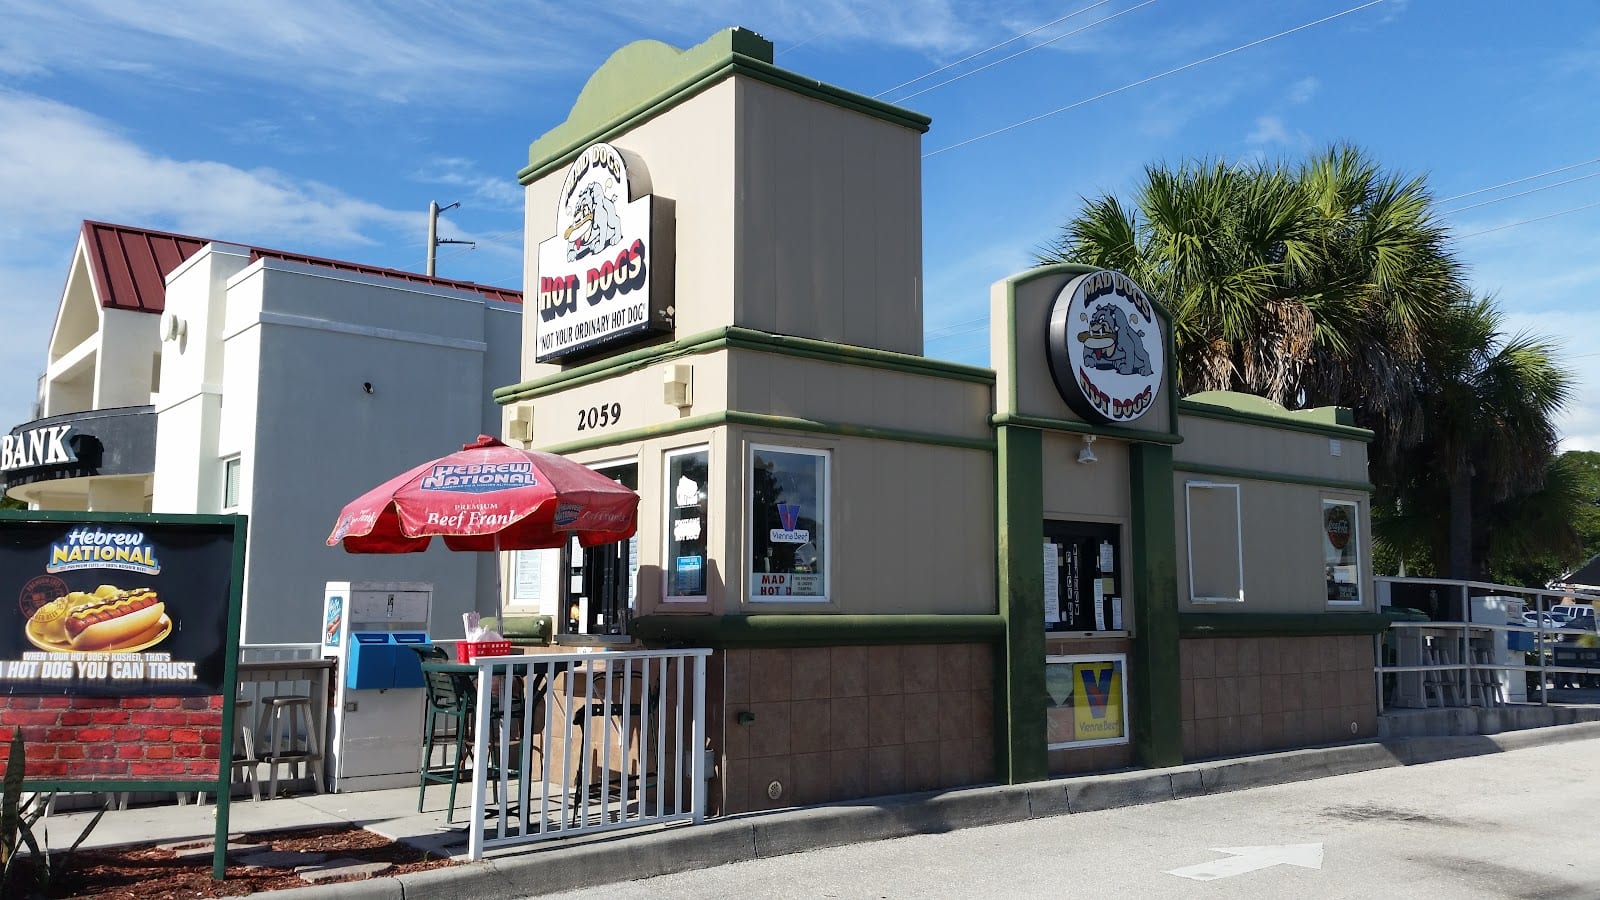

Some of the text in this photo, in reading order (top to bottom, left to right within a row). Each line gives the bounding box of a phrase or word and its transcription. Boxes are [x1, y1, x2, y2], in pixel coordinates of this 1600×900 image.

[565, 146, 621, 207] MAD DOGS
[540, 238, 647, 322] HOT DOGS
[1084, 271, 1152, 324] MAD DOGS
[555, 326, 573, 347] YOUR
[574, 314, 611, 340] ORDINARY
[611, 308, 626, 329] HOT
[1079, 366, 1153, 419] HOT DOGS
[577, 401, 622, 432] 2059
[0, 425, 74, 471] BANK
[424, 473, 537, 488] NATIONAL
[454, 503, 499, 511] PREMIUM
[427, 511, 466, 528] Beef
[69, 530, 144, 546] Hebrew
[772, 531, 809, 542] Vienna Beef
[53, 545, 155, 566] NATIONAL
[761, 575, 785, 584] MAD
[760, 587, 780, 595] HOT
[23, 651, 47, 660] WHEN
[48, 651, 69, 660] YOUR
[70, 652, 85, 660] HOT
[111, 653, 142, 662] KOSHER,
[145, 653, 171, 661] THAT'S
[7, 661, 39, 678] HOT
[41, 661, 74, 679] DOG
[77, 661, 107, 679] YOU
[111, 662, 144, 679] CAN
[147, 662, 197, 680] TRUST.
[1080, 720, 1103, 733] Vienna
